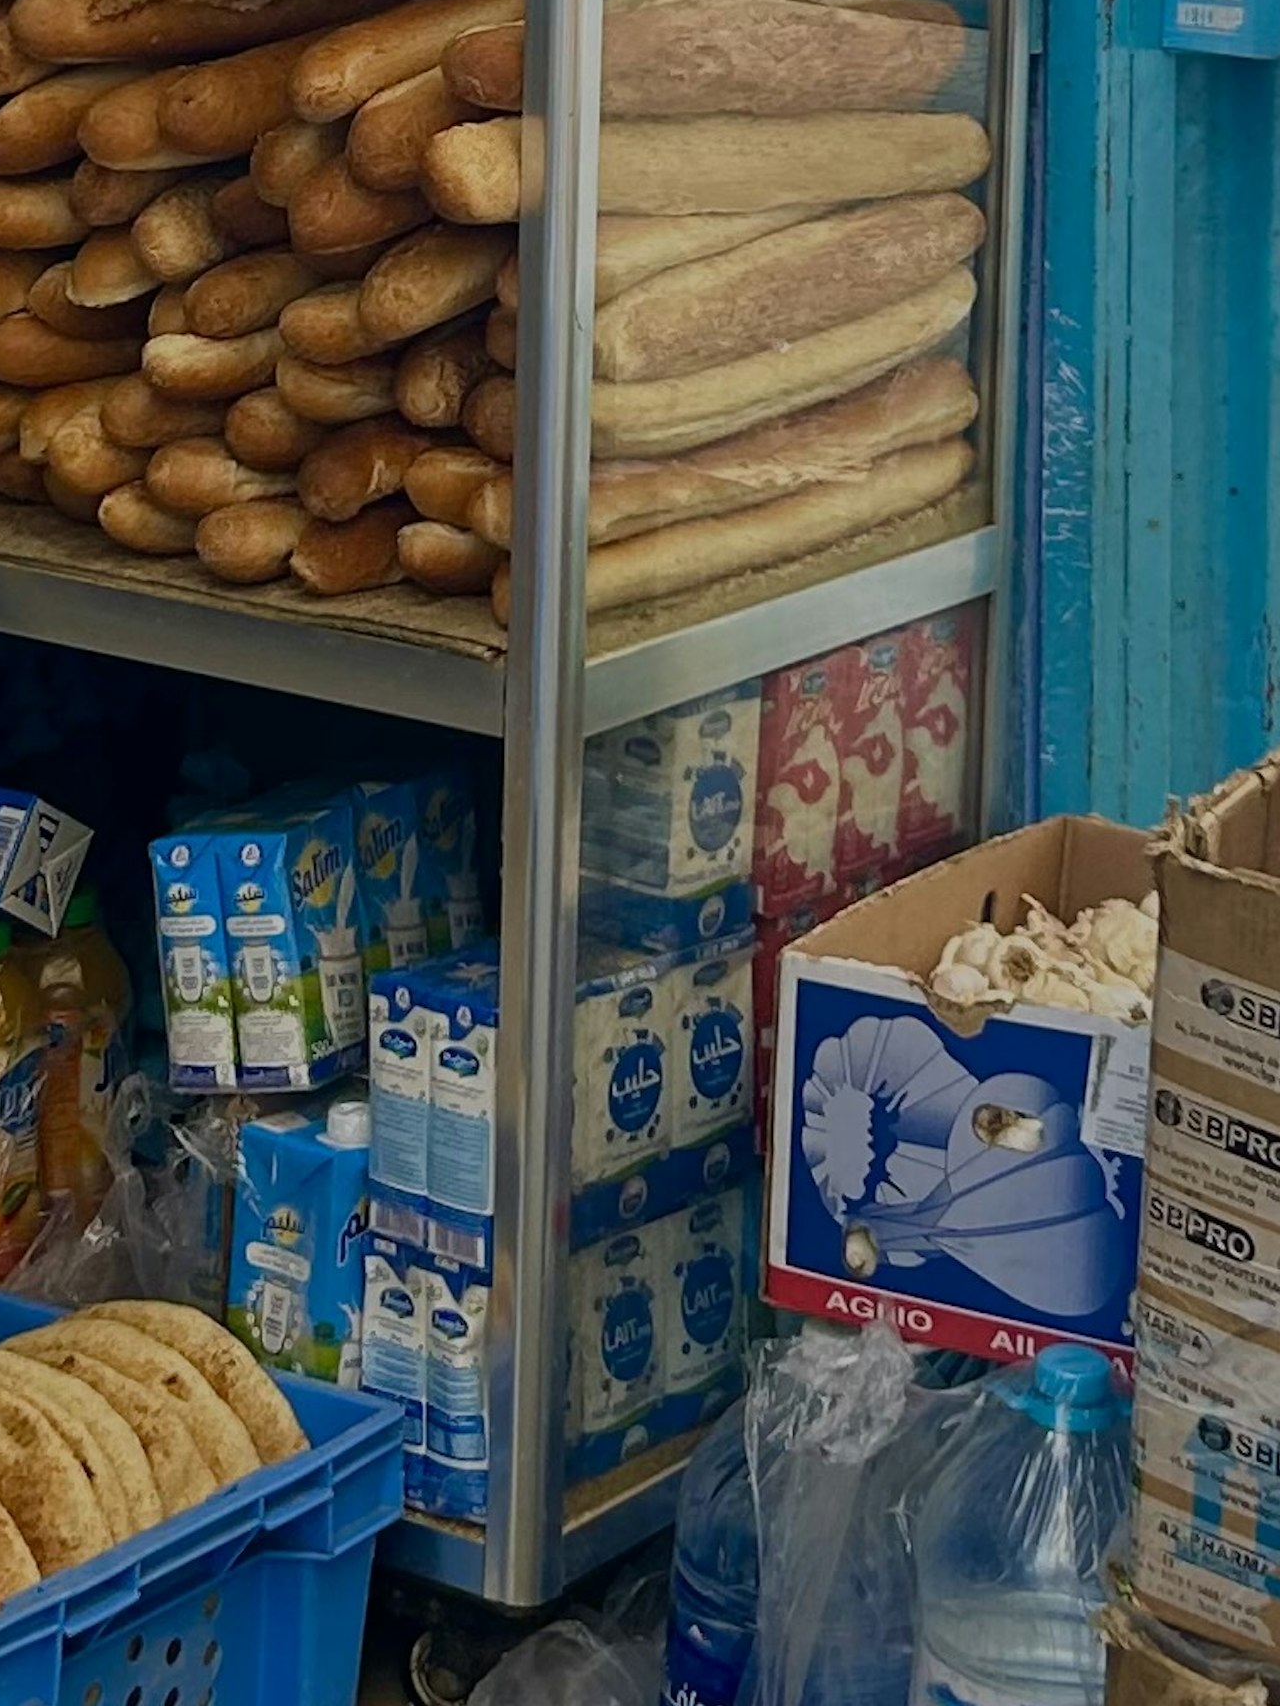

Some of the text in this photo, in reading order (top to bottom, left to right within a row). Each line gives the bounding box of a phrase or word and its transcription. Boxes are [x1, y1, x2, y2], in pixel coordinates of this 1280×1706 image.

[291, 841, 343, 910] Salim
[692, 1022, 742, 1068] حليب
[611, 1056, 662, 1100] حليب
[683, 1283, 718, 1316] LAIT
[601, 1317, 638, 1355] LAIT
